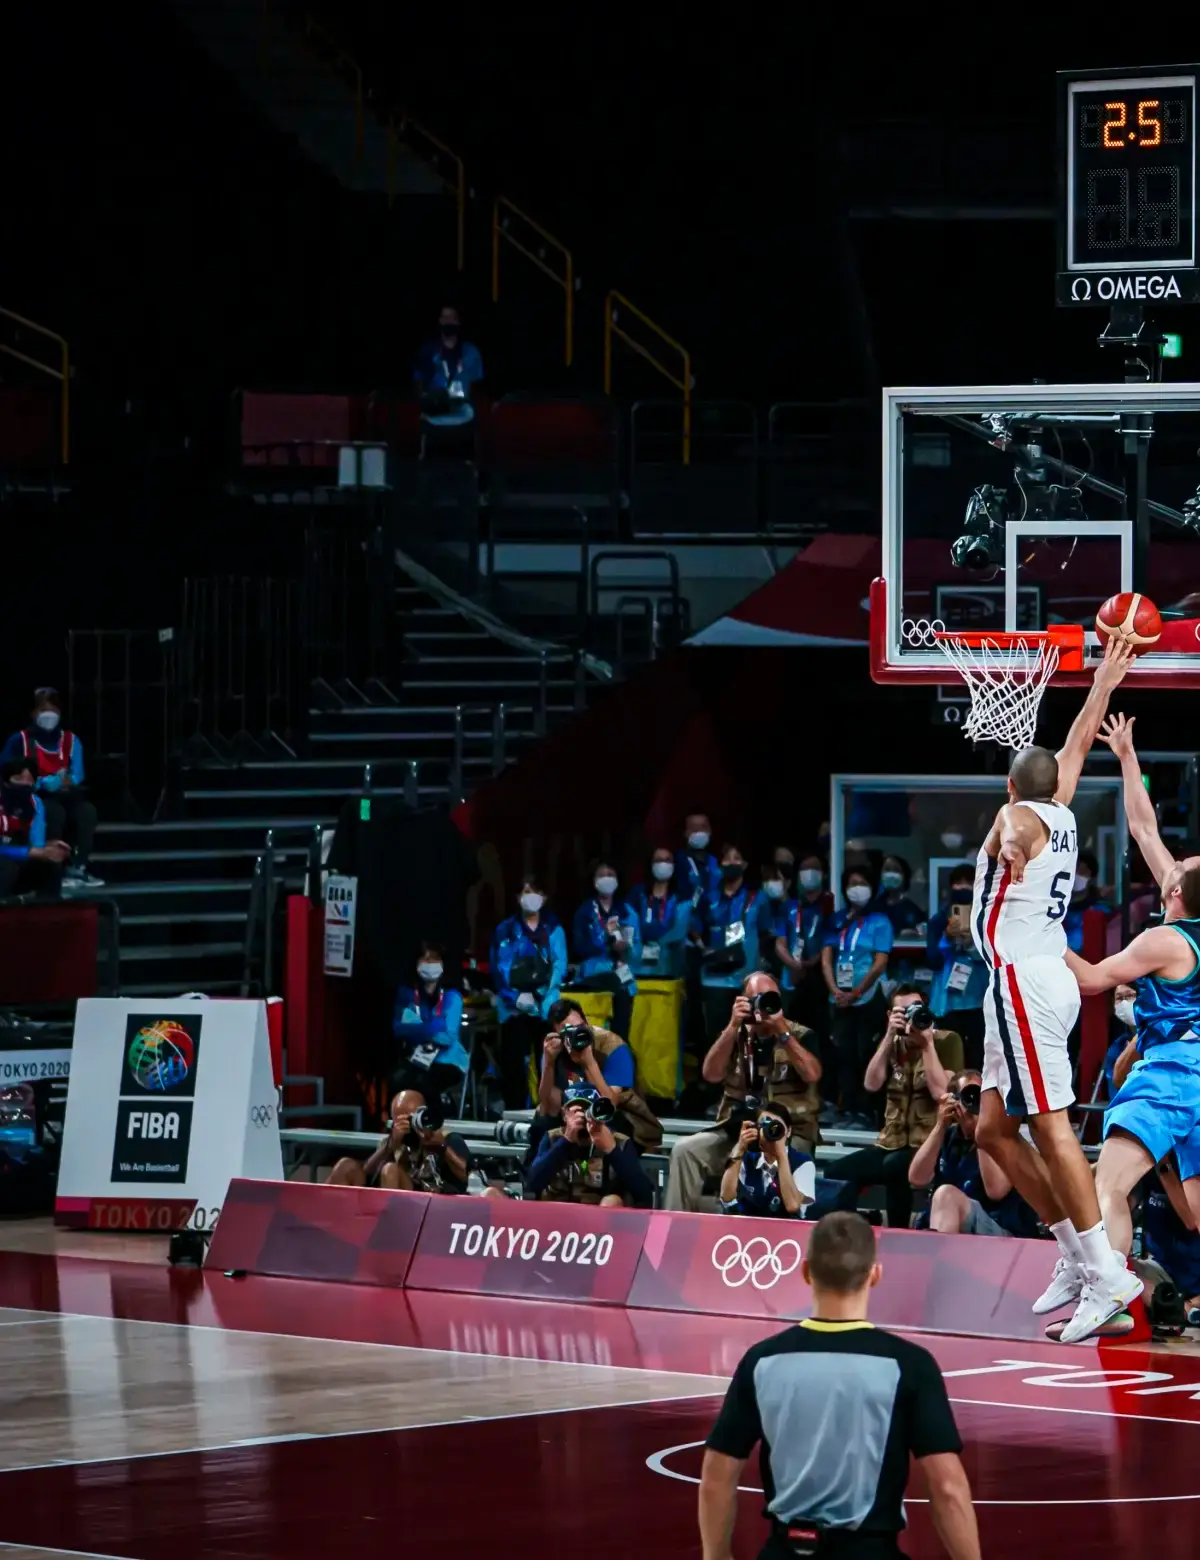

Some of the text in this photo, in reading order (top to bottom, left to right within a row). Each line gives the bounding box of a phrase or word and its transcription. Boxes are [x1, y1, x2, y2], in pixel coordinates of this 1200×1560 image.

[1103, 101, 1161, 147] 2.5
[1097, 275, 1182, 300] OMEGA
[1046, 871, 1071, 920] 5
[40, 1061, 71, 1077] 2020
[127, 1111, 181, 1140] FIBA
[92, 1204, 172, 1230] TOKYO
[449, 1222, 614, 1266] TOKYO 2020
